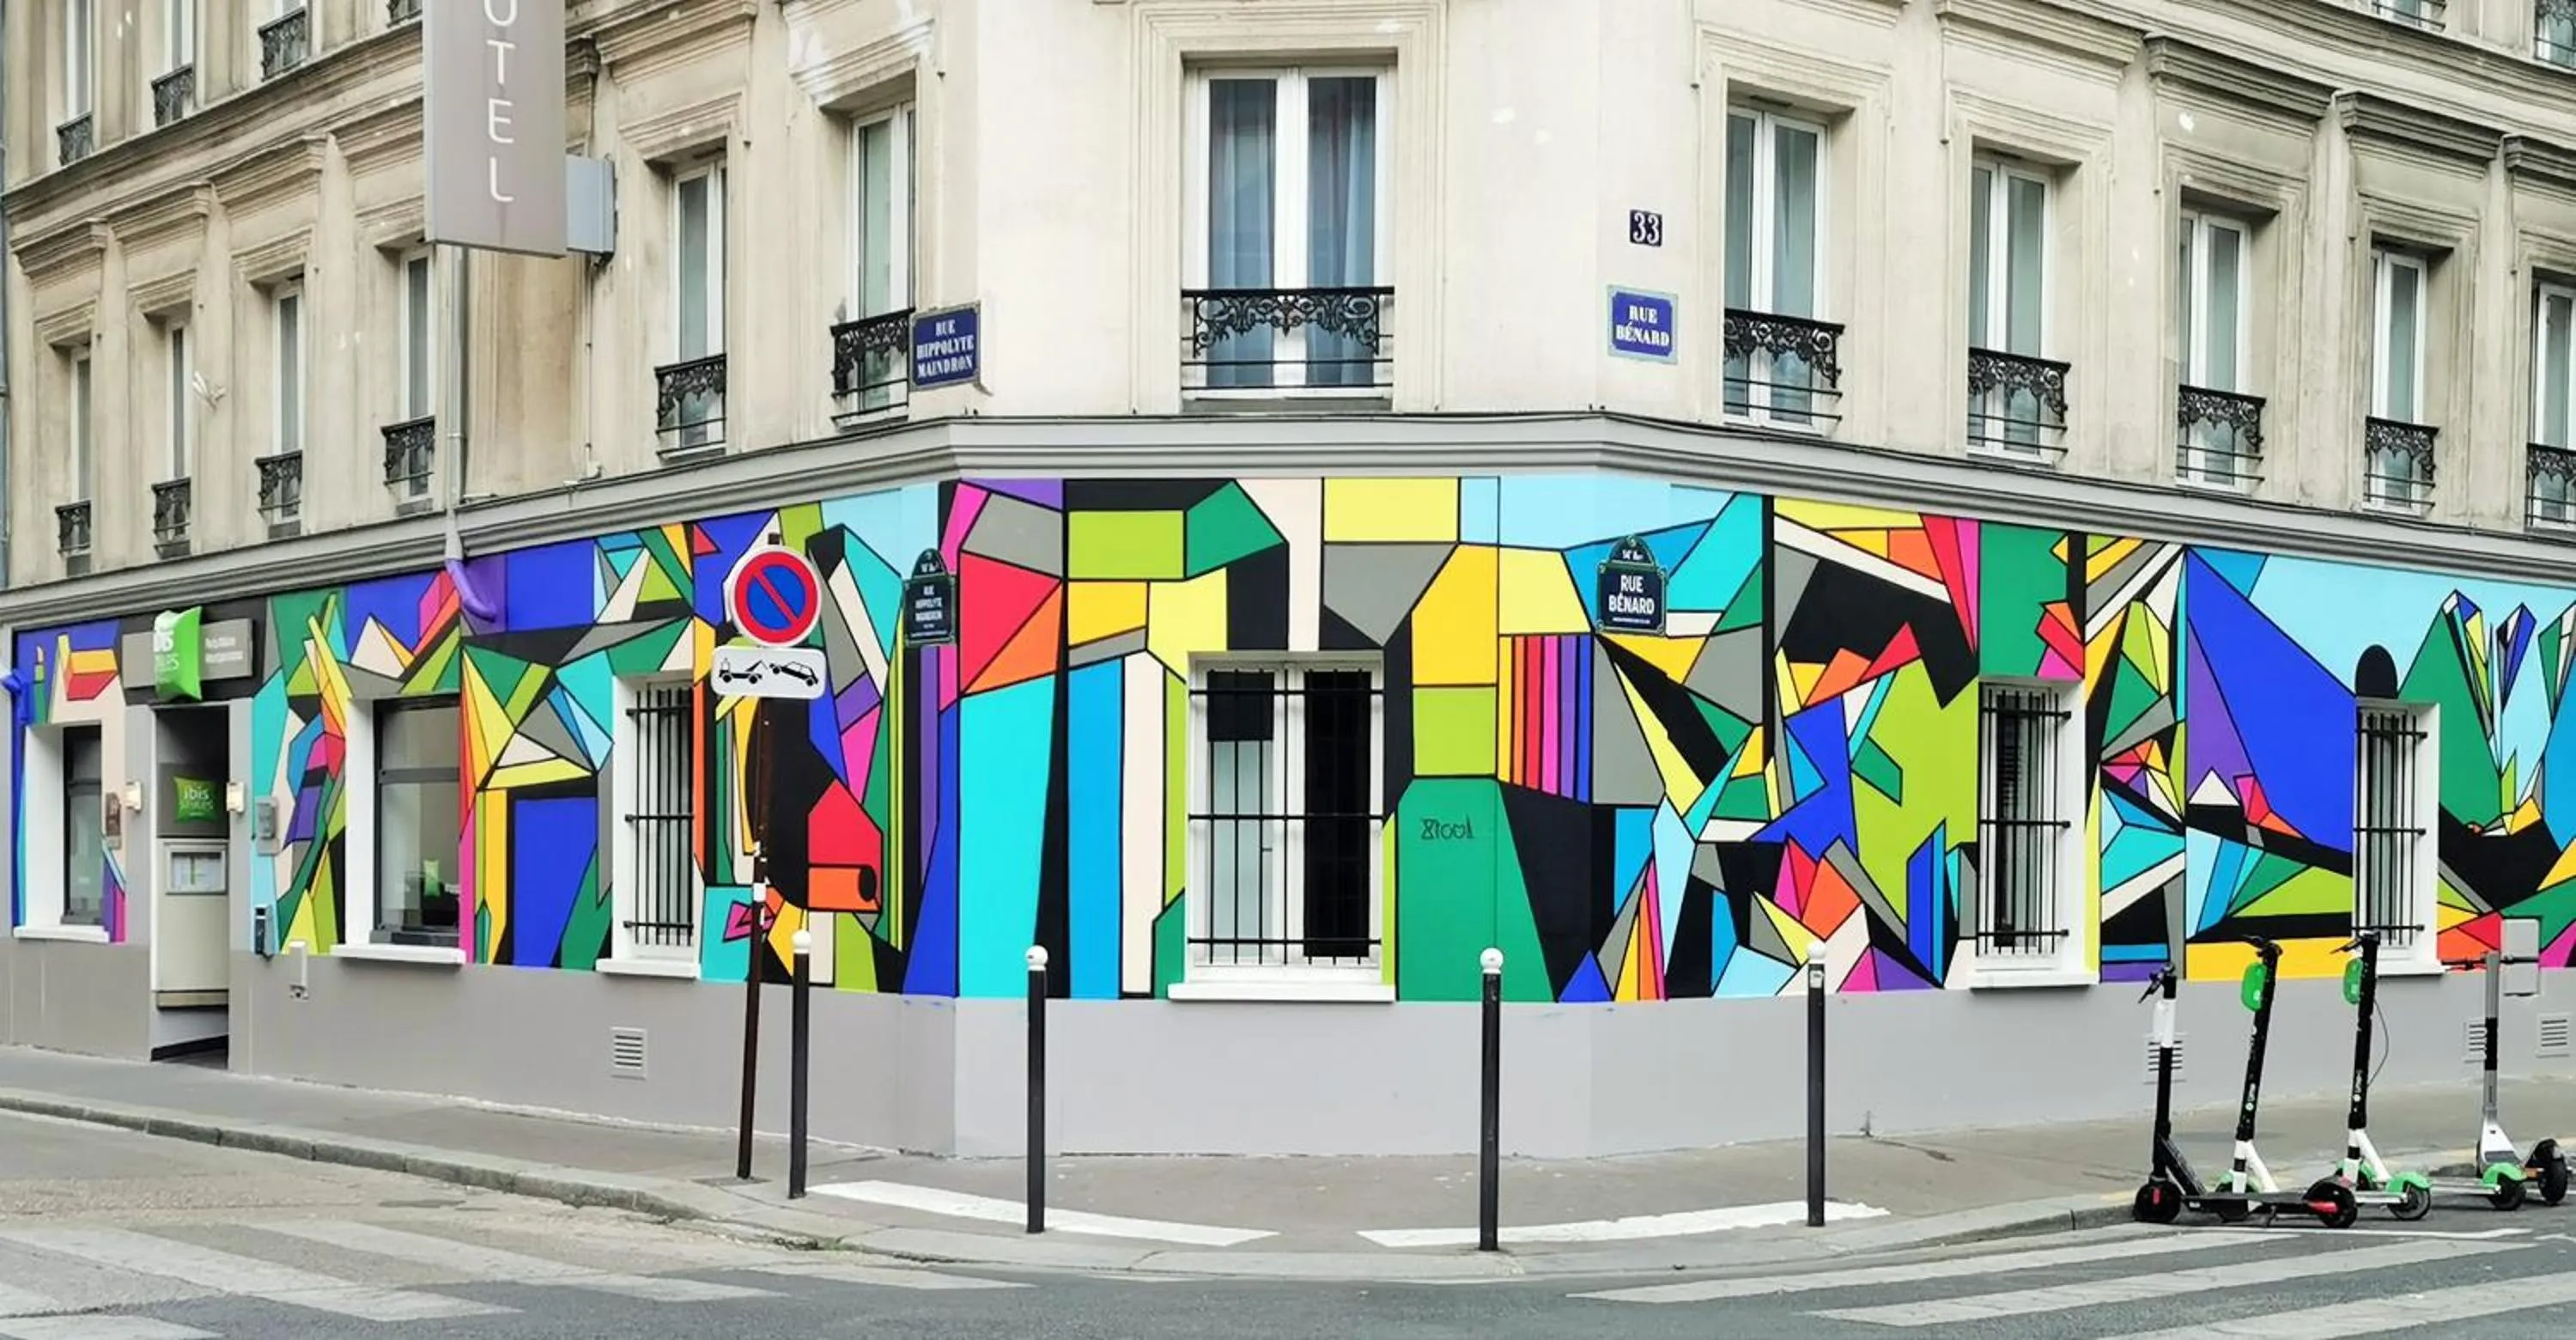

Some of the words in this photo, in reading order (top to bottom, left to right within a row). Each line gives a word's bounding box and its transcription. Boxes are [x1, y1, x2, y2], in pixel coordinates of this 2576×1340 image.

[1632, 211, 1660, 244] 33
[1628, 304, 1658, 324] RUE
[935, 319, 956, 337] RUE
[1615, 321, 1670, 347] BÉNARD
[916, 334, 974, 360] HIPPOLYTE
[1620, 575, 1643, 593] RUE
[1607, 591, 1656, 616] BÉNARD
